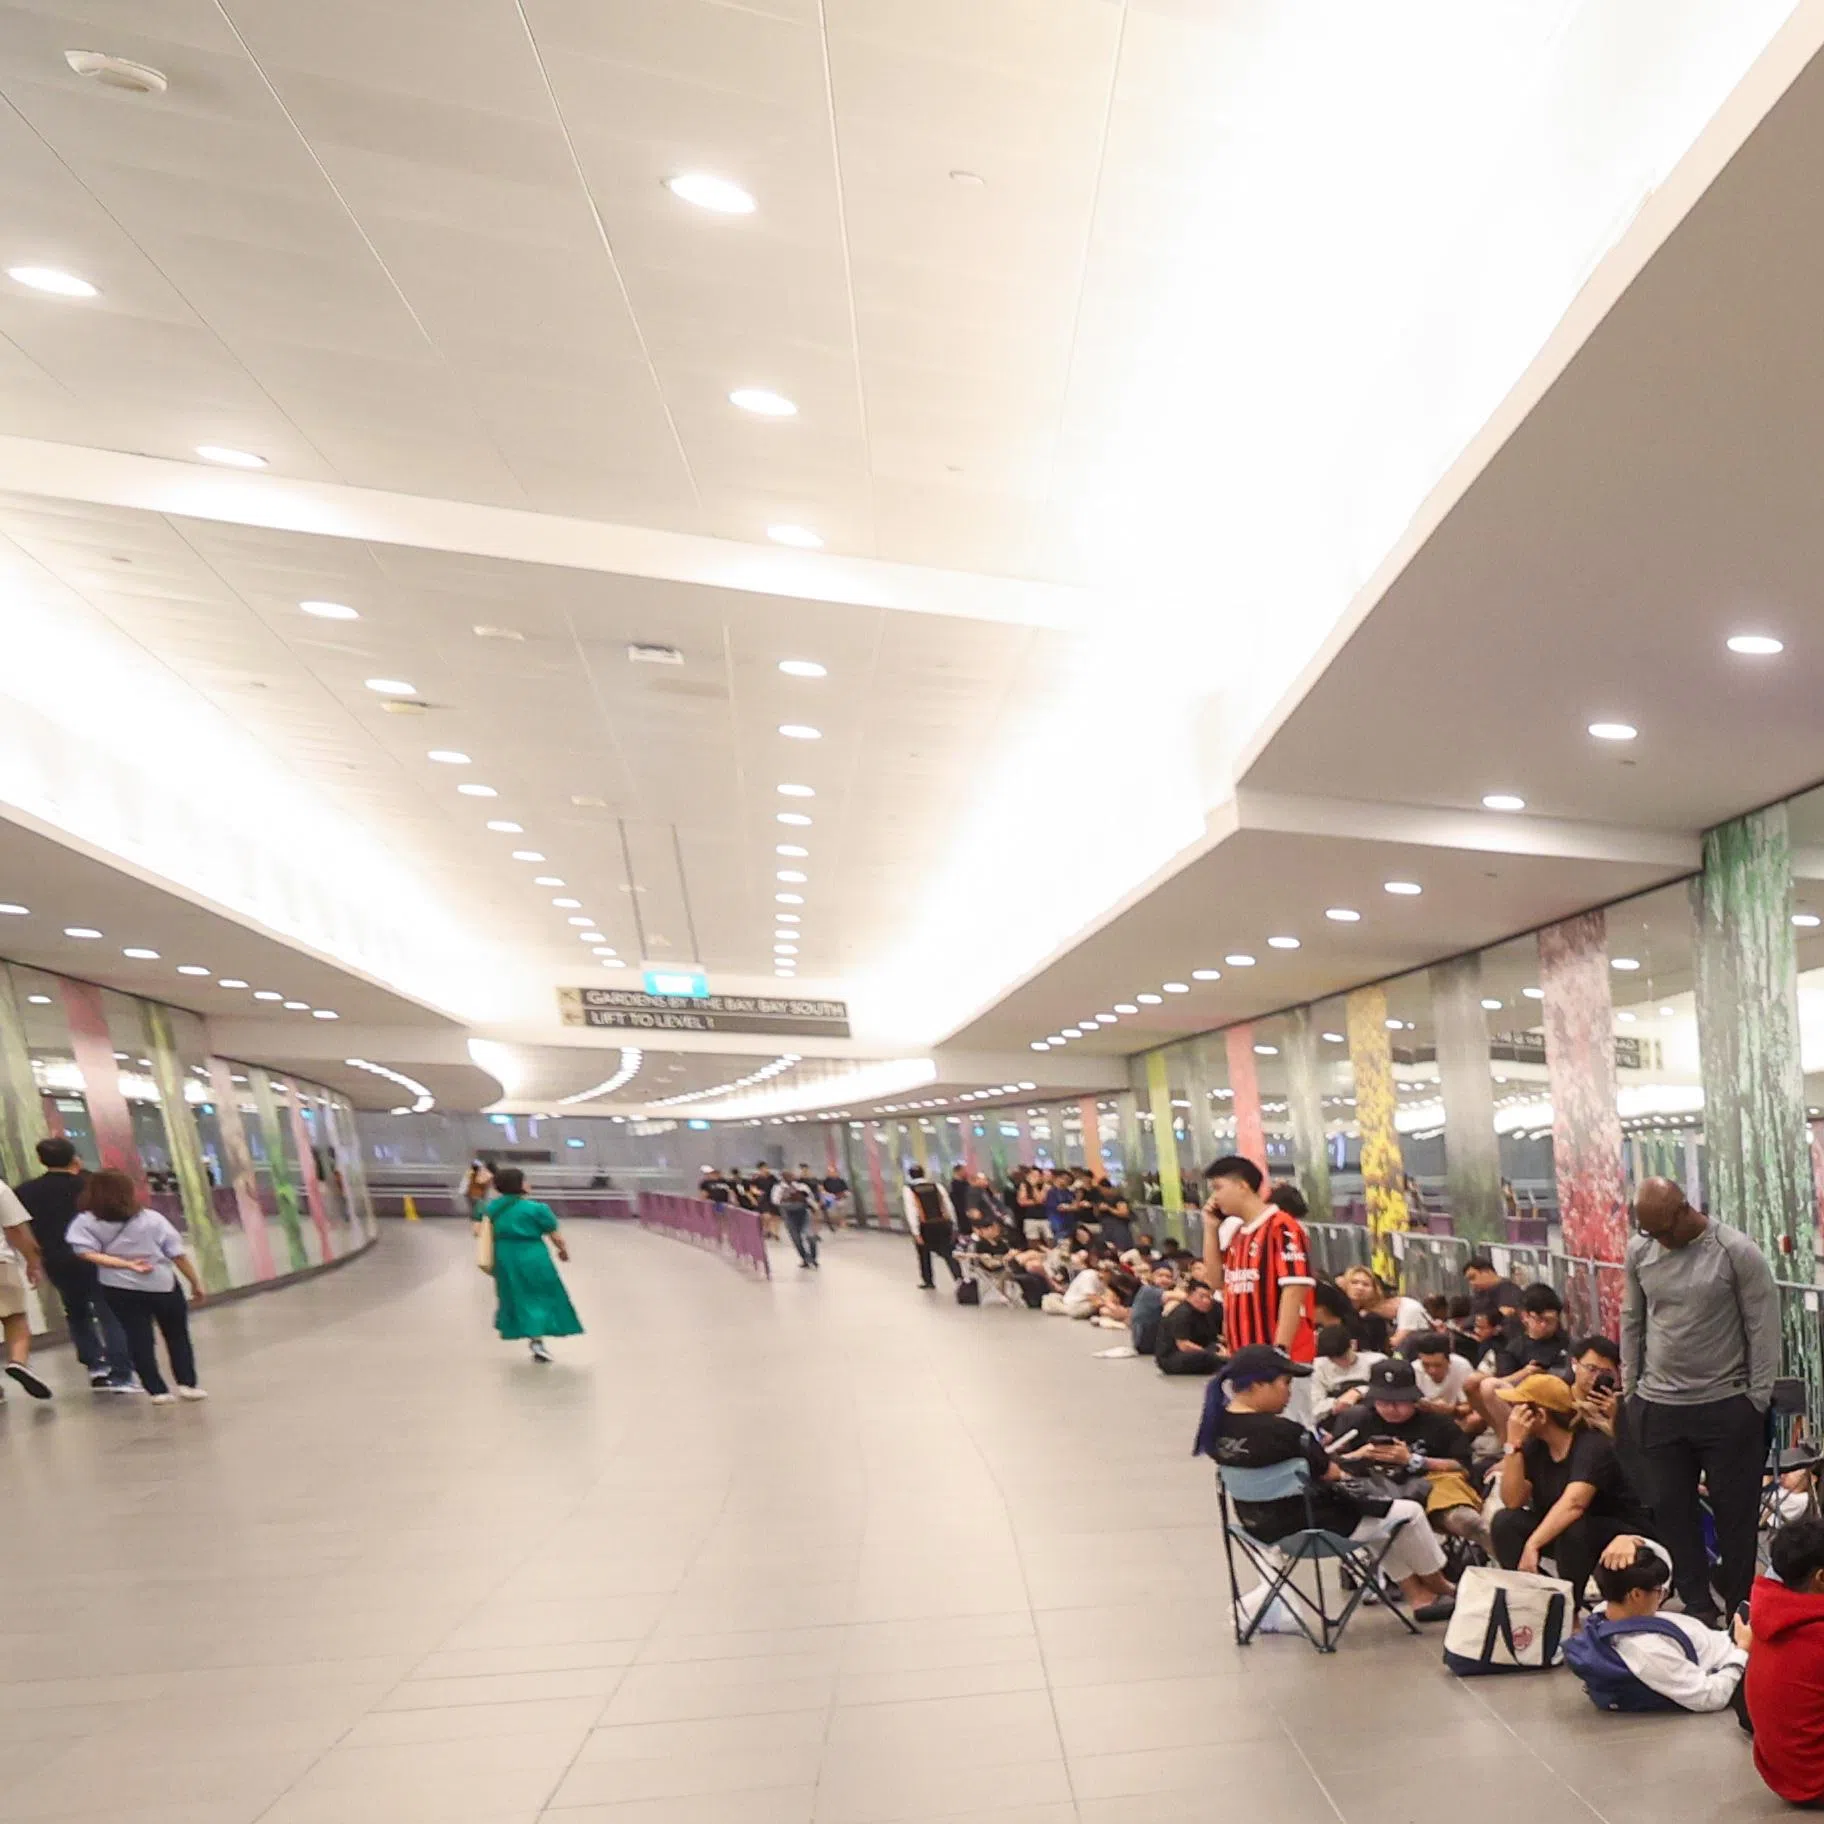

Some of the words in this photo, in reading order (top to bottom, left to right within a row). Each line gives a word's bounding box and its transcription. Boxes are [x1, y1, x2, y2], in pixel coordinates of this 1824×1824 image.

[586, 990, 668, 1008] GARDENS
[788, 1000, 846, 1018] SOUTH
[591, 1010, 627, 1025] LIFT
[629, 1011, 655, 1027] TO
[655, 1012, 707, 1030] LEVEL
